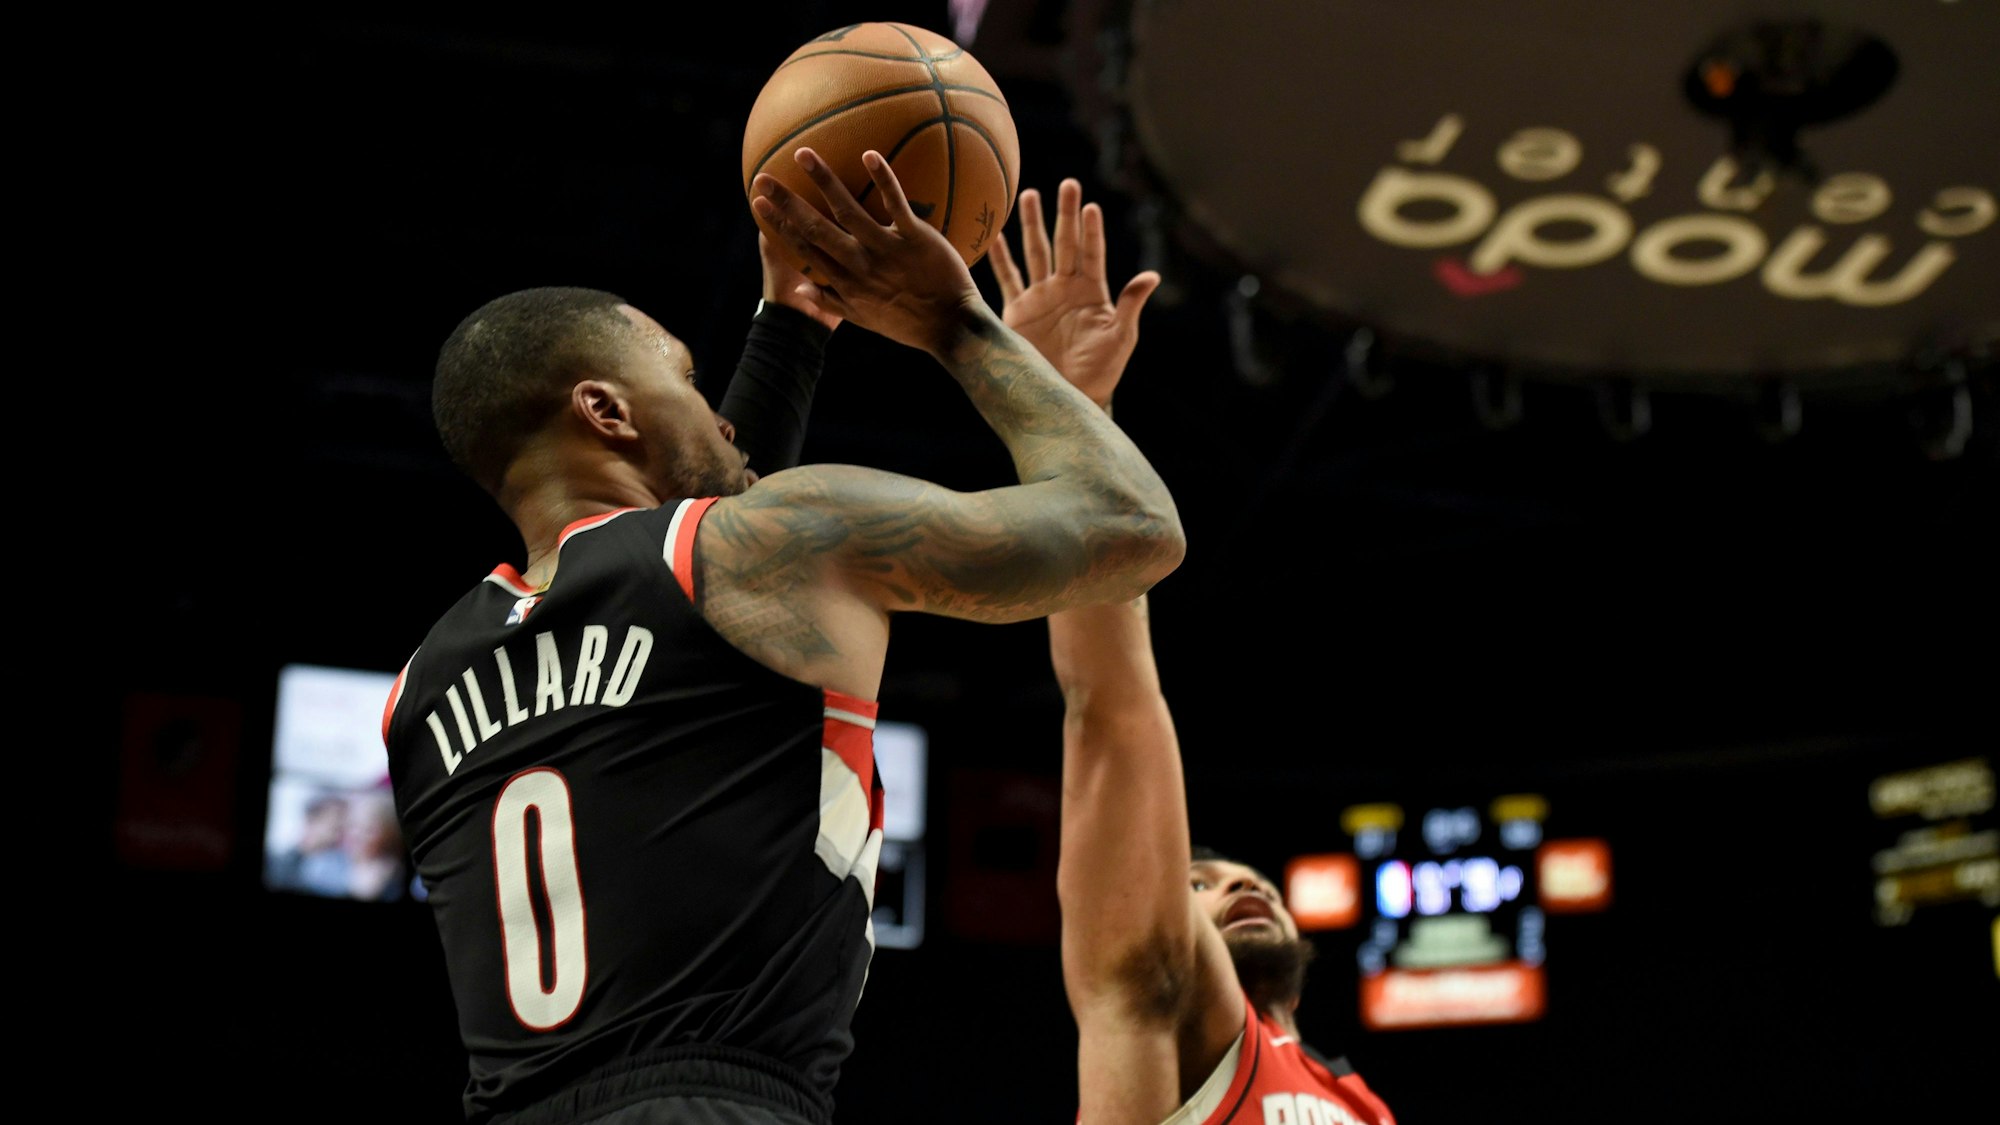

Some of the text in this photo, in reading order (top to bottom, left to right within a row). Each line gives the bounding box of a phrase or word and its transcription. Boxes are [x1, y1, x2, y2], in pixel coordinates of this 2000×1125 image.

[1357, 166, 1955, 305] moda
[1398, 113, 1998, 236] center
[426, 624, 654, 776] LILLARD
[491, 766, 588, 1032] 0
